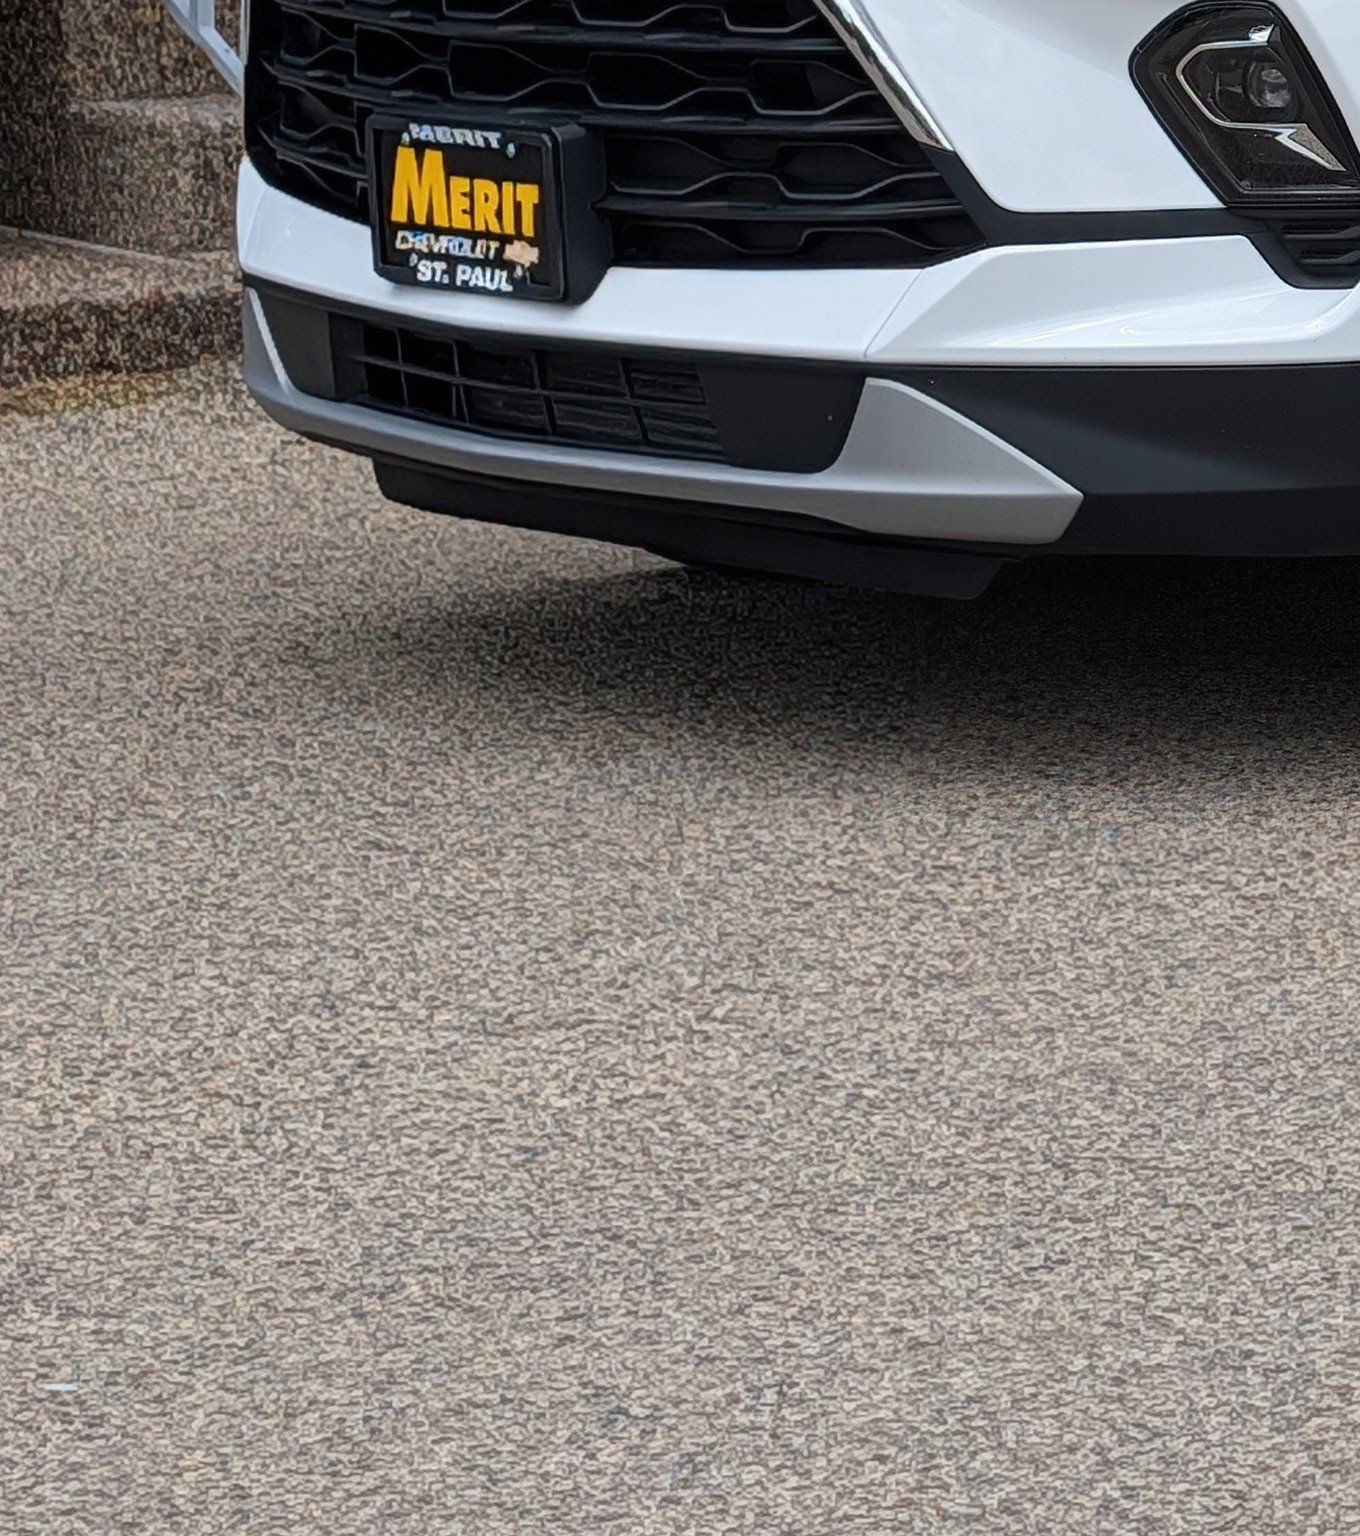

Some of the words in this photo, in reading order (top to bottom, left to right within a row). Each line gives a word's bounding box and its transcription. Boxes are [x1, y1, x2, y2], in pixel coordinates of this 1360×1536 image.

[390, 145, 539, 238] MERIT
[416, 259, 450, 284] ST.
[455, 264, 514, 293] PAUL
